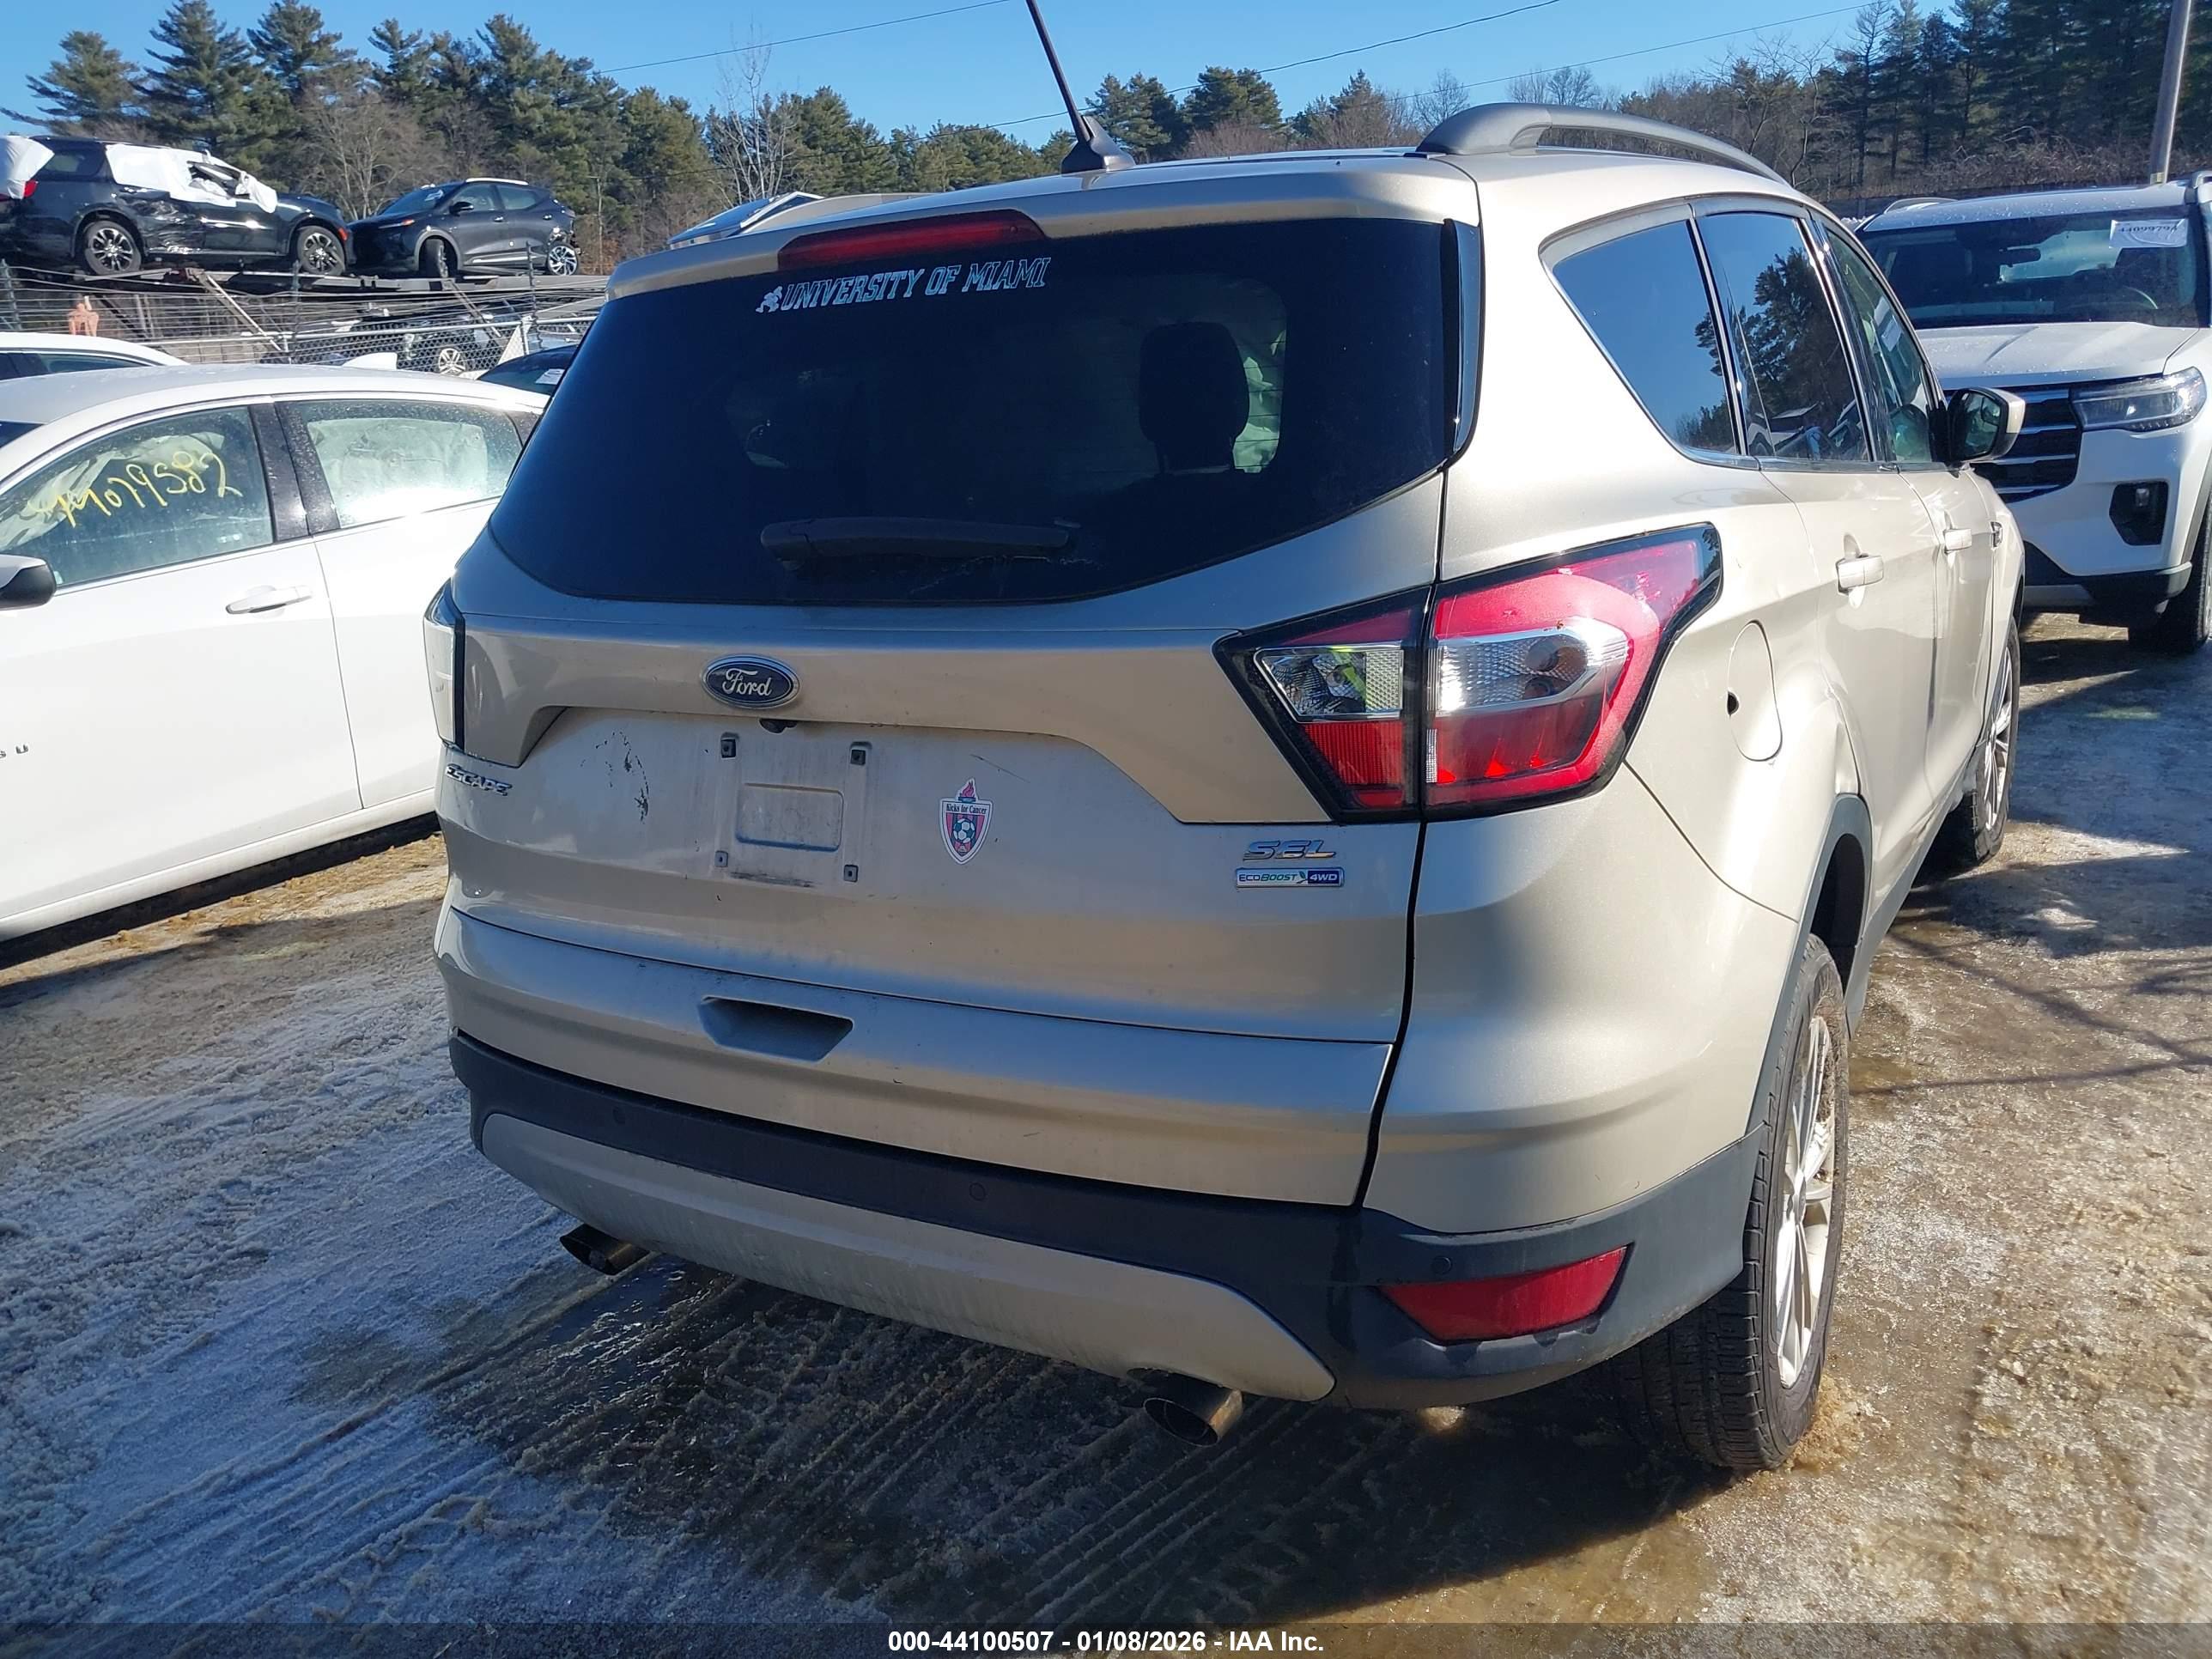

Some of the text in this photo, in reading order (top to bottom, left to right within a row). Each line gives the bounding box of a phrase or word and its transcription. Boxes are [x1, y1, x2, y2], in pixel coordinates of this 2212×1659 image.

[781, 258, 1052, 311] UNIVERSITY OF MIAMI
[722, 667, 773, 696] Ford
[445, 763, 513, 797] ESCAPE
[1243, 840, 1337, 860] SEL
